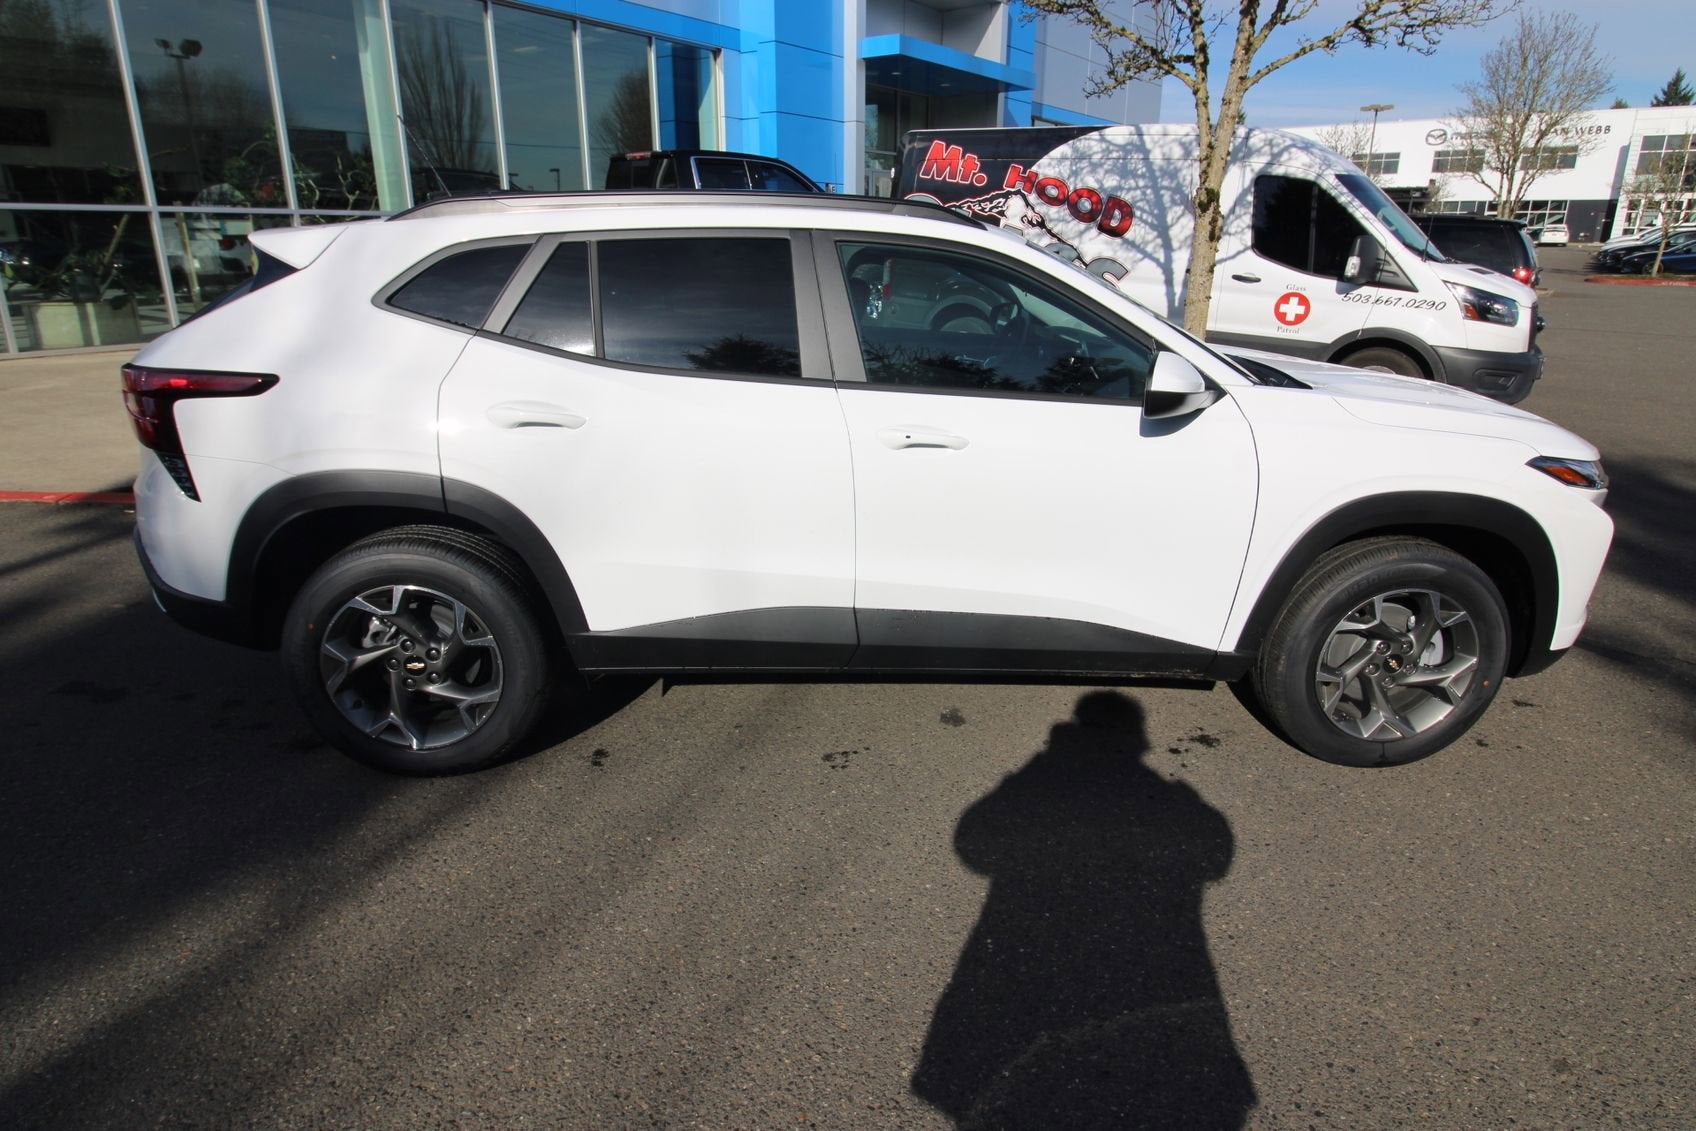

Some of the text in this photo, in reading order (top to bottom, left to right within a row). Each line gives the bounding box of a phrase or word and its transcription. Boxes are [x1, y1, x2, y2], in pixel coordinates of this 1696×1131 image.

[1575, 125, 1611, 136] WEBB
[920, 140, 987, 187] Mt.
[1003, 164, 1134, 238] HOOD
[1286, 284, 1307, 292] Glass
[1341, 292, 1447, 312] 503.667.0290
[1277, 326, 1300, 334] Patrol
